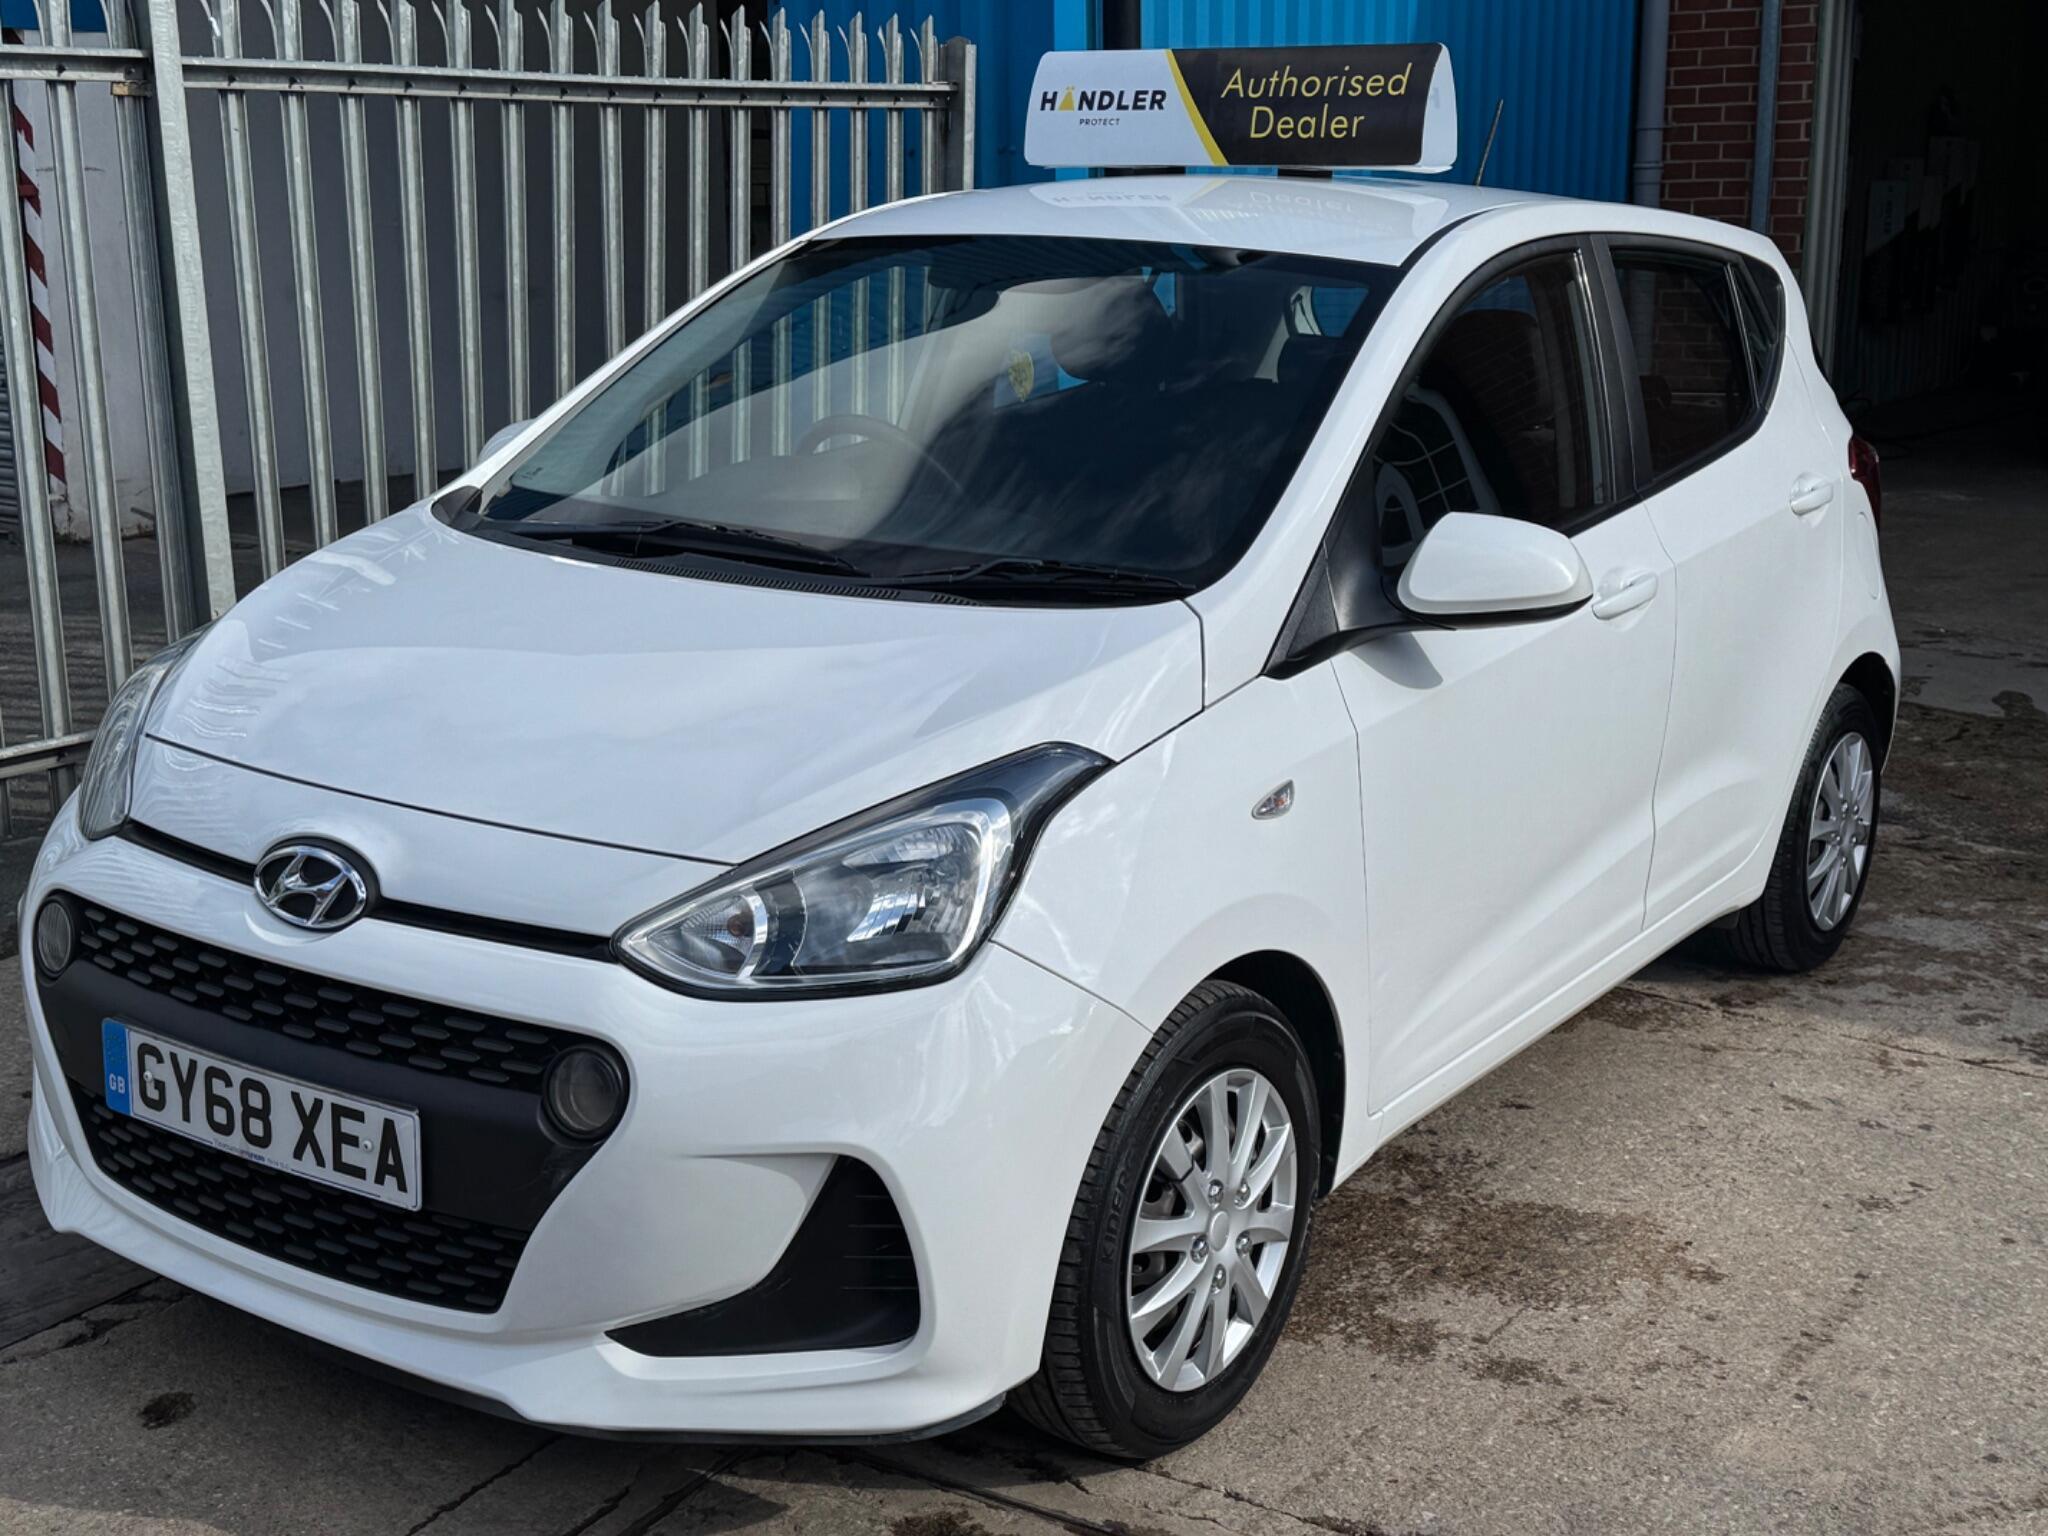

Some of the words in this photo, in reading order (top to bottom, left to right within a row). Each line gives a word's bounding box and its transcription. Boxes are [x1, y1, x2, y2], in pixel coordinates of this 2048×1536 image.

[1221, 63, 1412, 98] Authorised
[1079, 118, 1120, 126] PROTECT
[1250, 103, 1365, 138] Dealer
[109, 1073, 126, 1094] GB
[137, 1042, 272, 1150] GY68
[290, 1090, 408, 1194] XEA
